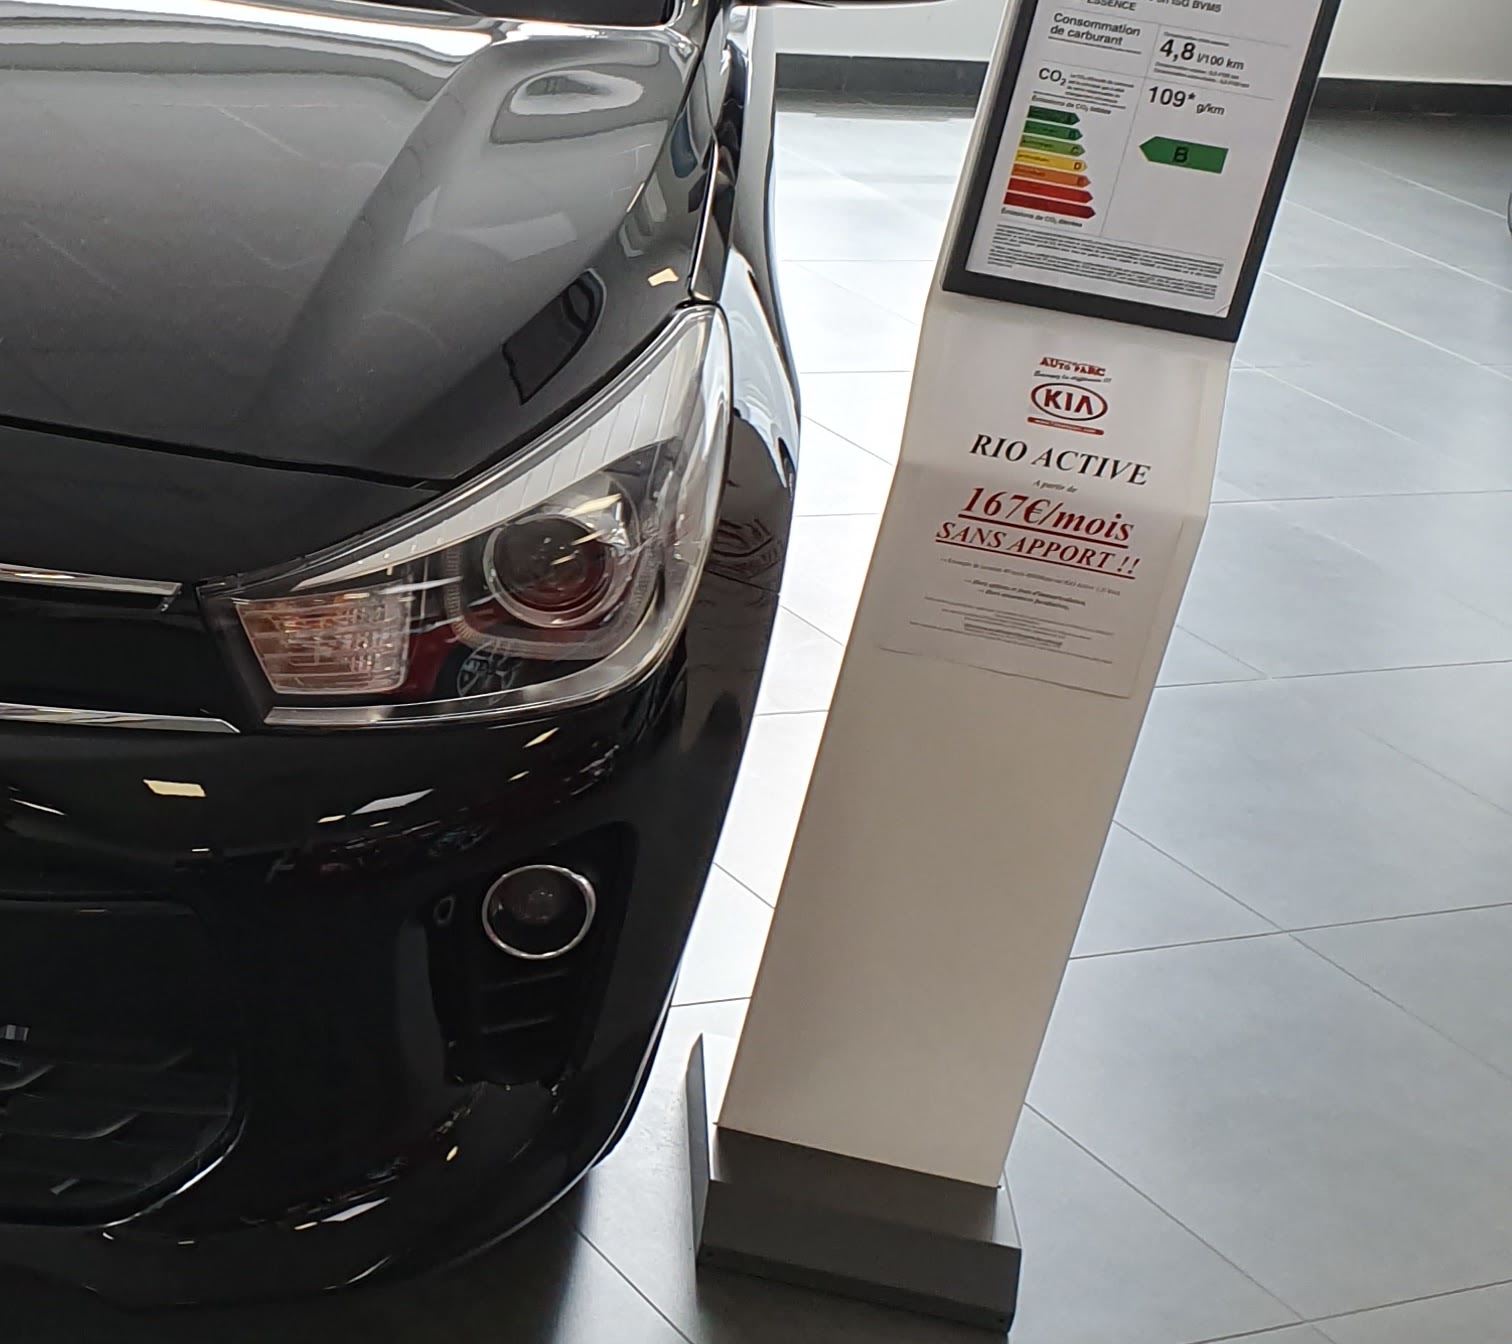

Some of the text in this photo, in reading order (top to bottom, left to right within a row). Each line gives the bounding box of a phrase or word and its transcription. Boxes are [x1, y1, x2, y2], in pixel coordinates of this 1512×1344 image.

[1049, 24, 1124, 46] de carburant
[1053, 12, 1141, 38] Consommation
[1159, 38, 1196, 62] 4,8
[1226, 58, 1245, 71] km
[1196, 103, 1225, 116] g/km
[1073, 161, 1082, 171] D
[1172, 146, 1188, 164] B
[1040, 356, 1071, 371] AUTO
[1074, 364, 1106, 377] PARC
[1044, 388, 1093, 416] KIA
[969, 434, 1151, 485] RIO ACTIVE
[962, 487, 1135, 542] 167€/mois
[937, 521, 1141, 575] SANS APPORT !!
